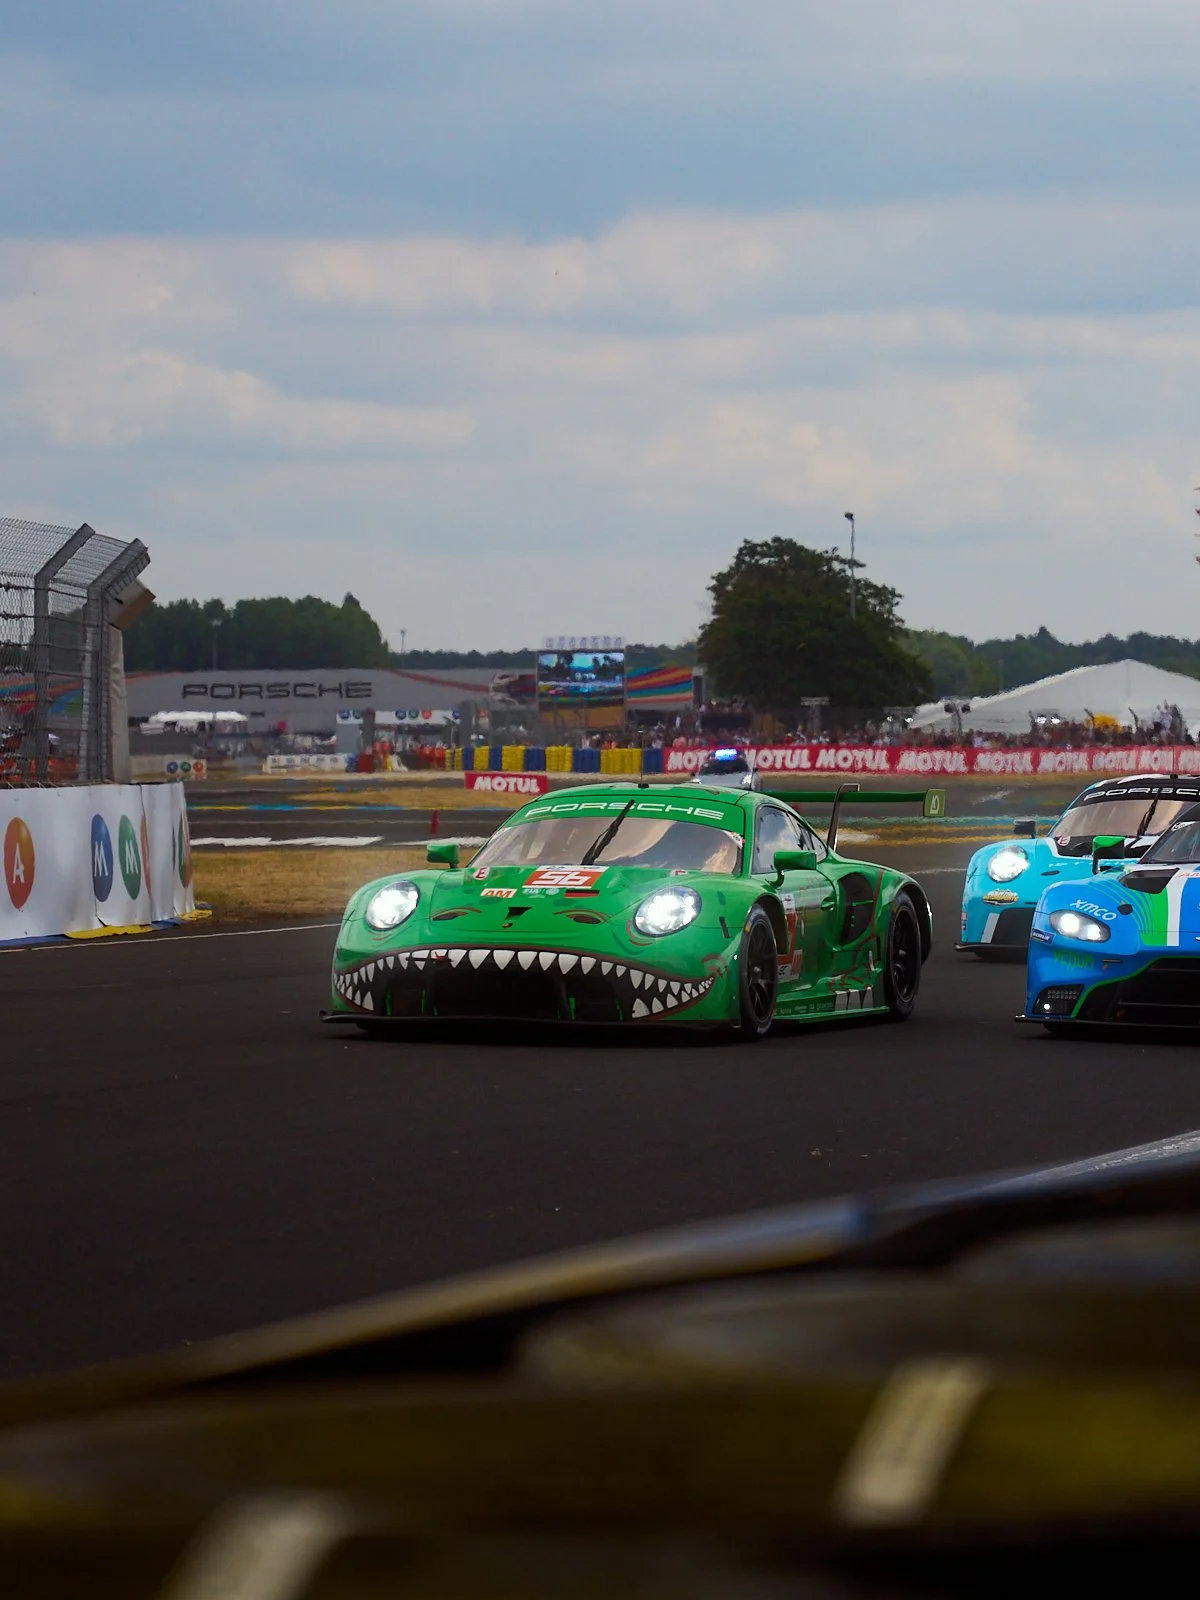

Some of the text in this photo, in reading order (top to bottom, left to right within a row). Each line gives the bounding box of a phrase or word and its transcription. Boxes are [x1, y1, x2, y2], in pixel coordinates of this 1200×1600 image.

[181, 682, 372, 699] PORSCHE
[667, 751, 703, 771] MOT
[815, 749, 890, 770] MOTUL
[898, 750, 968, 773] MOTUL
[473, 777, 541, 793] MOTUL
[524, 801, 724, 820] PORSCHE
[13, 843, 25, 884] A
[530, 871, 593, 886] 56
[485, 888, 512, 899] AM
[1070, 898, 1118, 921] xmco
